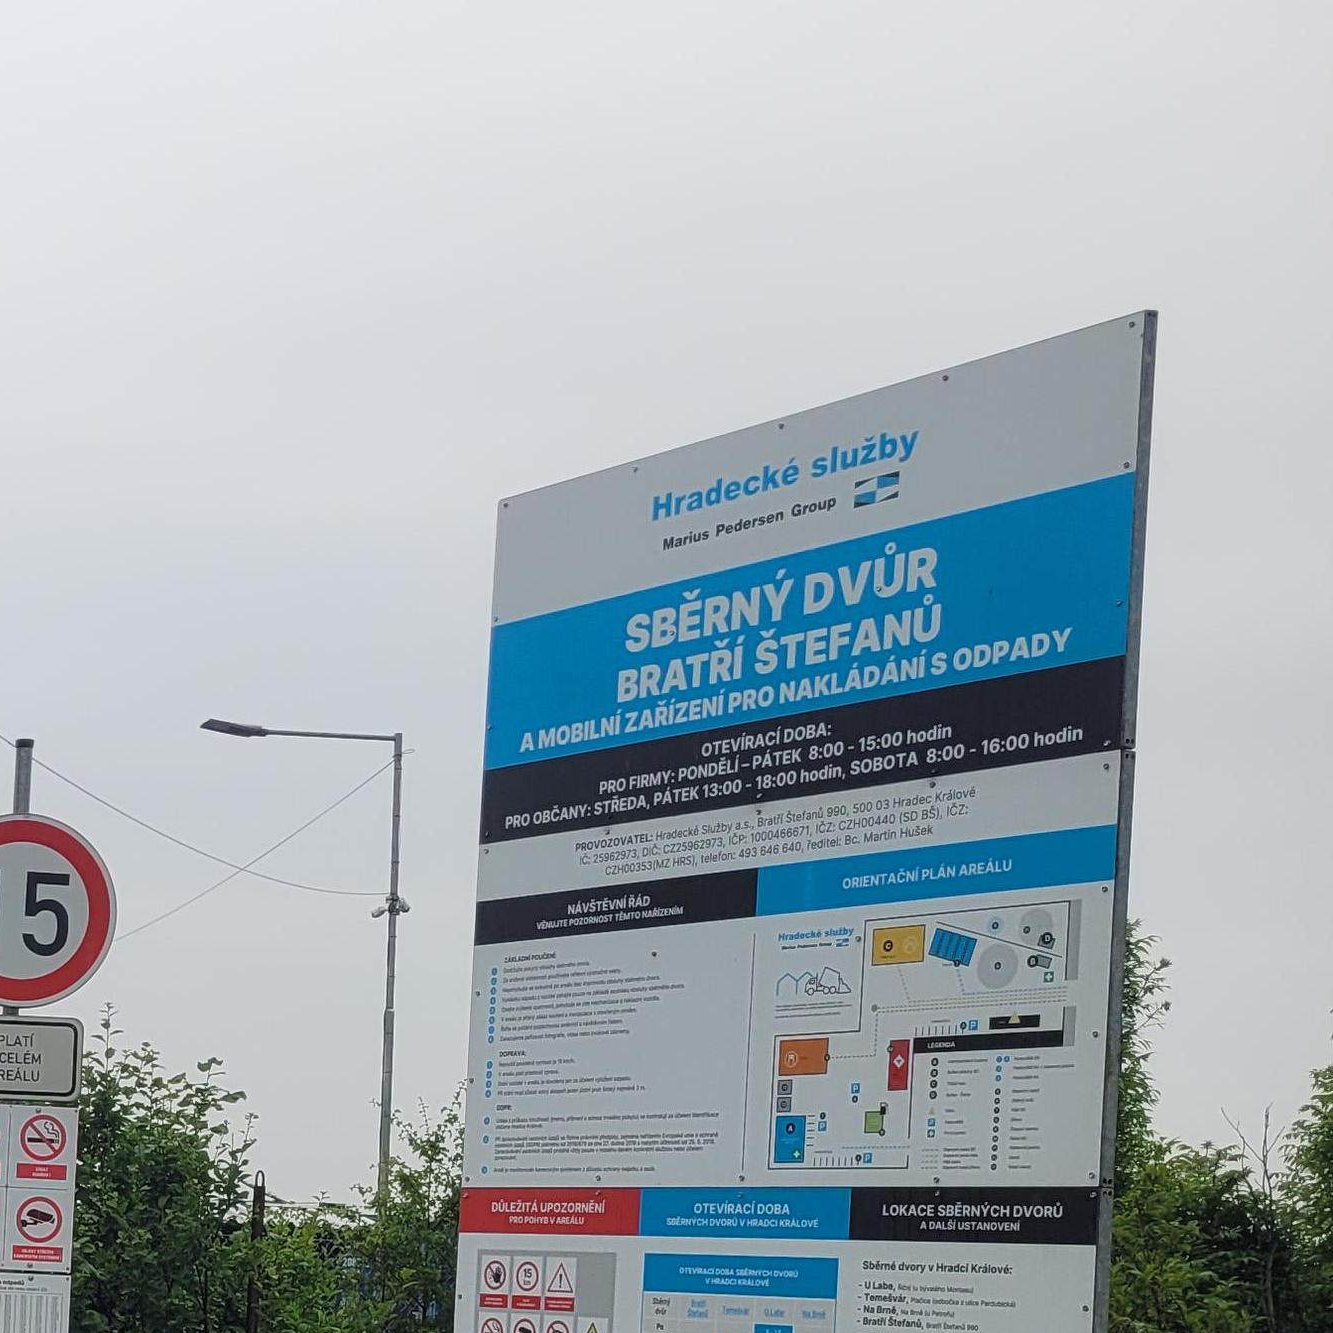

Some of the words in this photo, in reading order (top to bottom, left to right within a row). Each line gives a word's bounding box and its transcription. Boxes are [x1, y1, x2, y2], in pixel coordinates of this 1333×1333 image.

[651, 457, 800, 521] Hradecké
[810, 430, 919, 479] služby
[662, 528, 709, 551] Marius
[715, 511, 784, 536] Pedersen
[791, 497, 837, 518] Group
[625, 568, 794, 653] SBĚRNÝ
[803, 542, 937, 615] DVŮR
[617, 635, 746, 703] BRATŘÍ
[754, 594, 941, 675] ŠTEFANŮ
[519, 732, 533, 752] A
[538, 708, 621, 749] MOBILNÍ
[624, 692, 725, 733] ZAŘÍZENÍ
[728, 685, 775, 714] PRO
[778, 650, 926, 704] NAKLÁDÁNÍ
[931, 652, 947, 676] S
[953, 627, 1072, 671] ODPADY
[701, 726, 781, 757] OTEVÍRACÍ
[783, 722, 832, 743] DOBA:
[599, 778, 626, 795] PRO
[629, 770, 675, 790] FIRMY:
[678, 755, 739, 783] PONDĚLÍ
[752, 745, 801, 770] PÁTEK
[808, 743, 843, 761] 8:00
[859, 732, 902, 752] 15:00
[906, 723, 952, 745] hodin
[505, 813, 530, 830] PRO
[533, 803, 591, 826] OBČANY:
[593, 793, 650, 816] STŘEDA,
[653, 783, 699, 806] PÁTEK
[702, 780, 742, 798] 13:00
[755, 770, 796, 790] 18:00
[799, 764, 846, 785] hodin,
[850, 754, 918, 776] SOBOTA
[926, 744, 965, 764] 8:00
[981, 734, 1030, 756] 16:00
[1034, 726, 1083, 748] hodin
[575, 831, 653, 852] PROVOZOVATEL:
[656, 825, 699, 842] Hradecké
[701, 822, 732, 839] Služby
[785, 806, 824, 825] Štefanů
[827, 804, 849, 819] 990,
[852, 801, 873, 814] 500
[876, 799, 890, 812] 03
[893, 791, 933, 809] Hradec
[935, 785, 976, 804] Králové
[593, 847, 639, 864] 25962973,
[642, 843, 660, 859] DIČ:
[663, 838, 725, 855] CZ25962973,
[728, 832, 747, 847] IČP:
[750, 826, 812, 844] 1000466671,
[815, 819, 836, 835] IČZ:
[838, 813, 896, 832] CZH00440
[899, 810, 919, 826] (SD
[921, 806, 943, 822] BŠ),
[946, 802, 969, 818] IČZ:
[605, 857, 670, 877] CZH00353(MZ
[672, 853, 698, 870] HRS),
[700, 850, 736, 865] telefon:
[738, 845, 757, 860] 493
[760, 843, 779, 858] 646
[782, 841, 804, 855] 640,
[806, 834, 842, 851] ředitel:
[844, 833, 861, 847] Bc.
[863, 829, 898, 845] Martin
[900, 824, 933, 839] Hušek
[842, 866, 919, 890] ORIENTAČNÍ
[921, 861, 956, 881] PLÁN
[958, 859, 1013, 877] AREÁLU
[567, 894, 627, 916] NÁVŠTĚVNÍ
[628, 893, 651, 909] ŘÁD
[536, 915, 569, 931] VĚNUJTE
[568, 912, 614, 927] POZORNOST
[641, 904, 684, 919] NAŘÍZENÍM
[778, 929, 822, 943] Hradecké
[824, 926, 855, 939] služby
[0, 1049, 42, 1065] CELÉM
[491, 1198, 538, 1214] DŮLEŽITÁ
[540, 1199, 606, 1214] UPOZORNĚNÍ
[694, 1200, 756, 1215] OTEVÍRACÍ
[757, 1203, 790, 1216] DOBA
[882, 1204, 935, 1218] LOKACE
[937, 1201, 1010, 1218] SBĚRNÝCH
[1013, 1202, 1063, 1219] DVORŮ
[509, 1215, 524, 1224] PRO
[524, 1216, 549, 1225] POHYB
[556, 1215, 585, 1225] AREÁLU
[666, 1215, 709, 1227] SBĚRNÝCH
[709, 1217, 738, 1228] DVORŮ
[747, 1218, 779, 1228] HRADCI
[779, 1217, 819, 1229] KRÁLOVÉ
[929, 1219, 957, 1231] DALŠÍ
[958, 1220, 1021, 1232] USTANOVENÍ
[523, 1268, 533, 1279] 15
[862, 1259, 896, 1272] Sběrné
[898, 1261, 926, 1275] dvory
[936, 1262, 968, 1274] Hradci
[970, 1262, 1013, 1275] Králové:
[872, 1281, 896, 1292] Labe,
[864, 1292, 910, 1305] Temešvár,
[887, 1316, 925, 1330] Štefanů,
